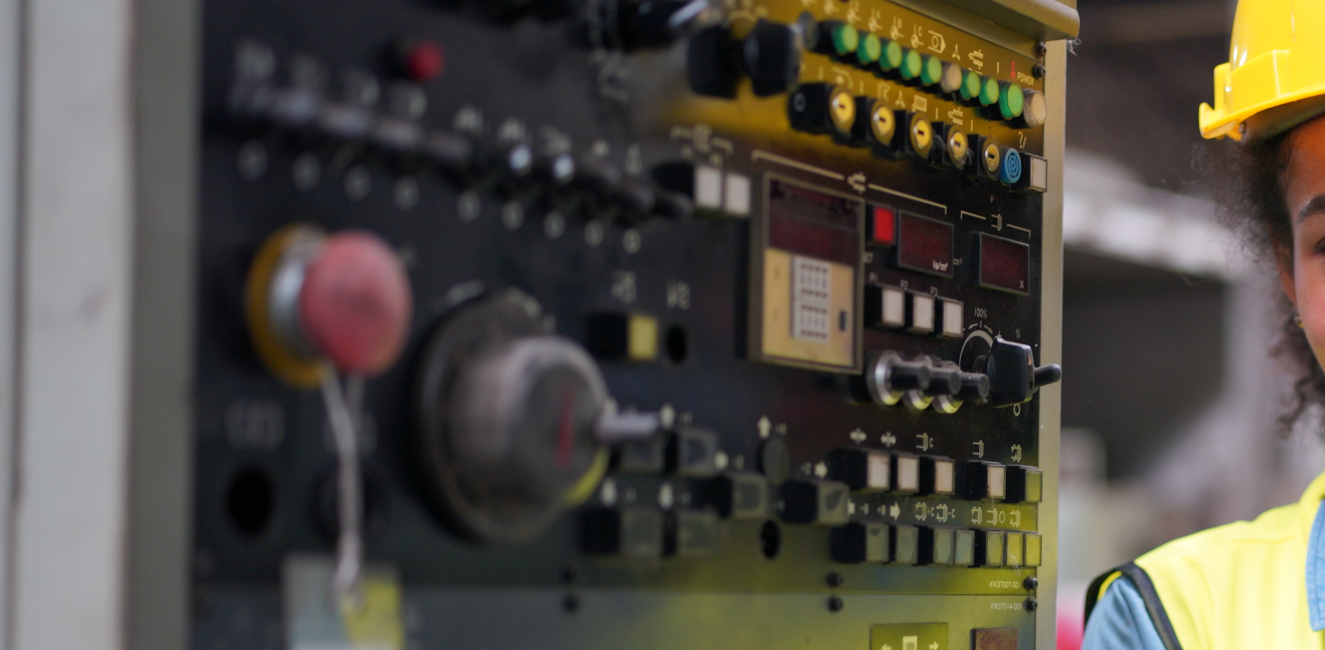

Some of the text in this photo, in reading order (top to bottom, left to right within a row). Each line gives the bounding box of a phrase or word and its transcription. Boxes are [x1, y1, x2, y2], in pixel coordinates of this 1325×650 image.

[917, 26, 923, 37] C
[1017, 71, 1035, 86] POWER
[900, 280, 909, 290] P2
[930, 286, 938, 297] P3
[974, 307, 988, 319] 100%
